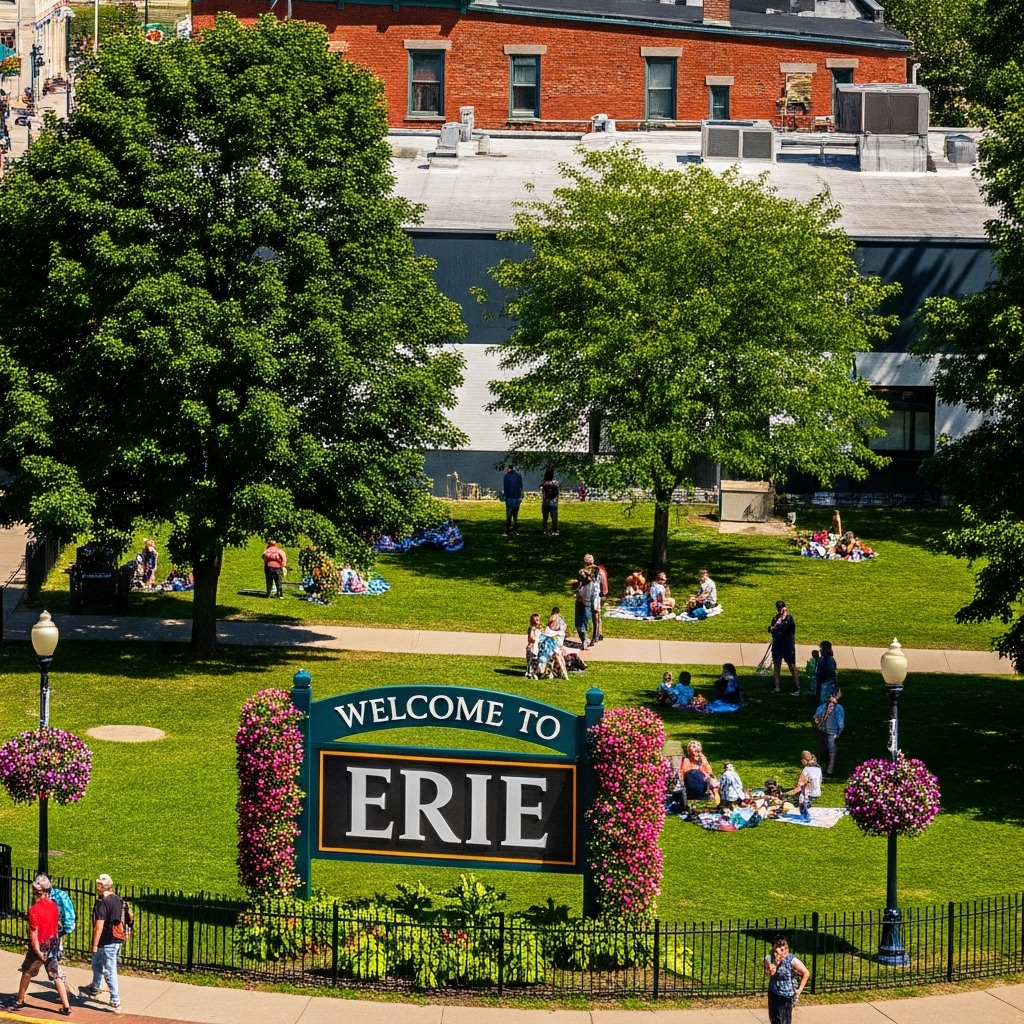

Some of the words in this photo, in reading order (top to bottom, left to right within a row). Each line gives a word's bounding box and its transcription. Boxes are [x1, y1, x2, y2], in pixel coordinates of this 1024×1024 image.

[334, 694, 504, 728] WELCOME
[518, 706, 561, 740] TO
[345, 766, 549, 849] ERIE
